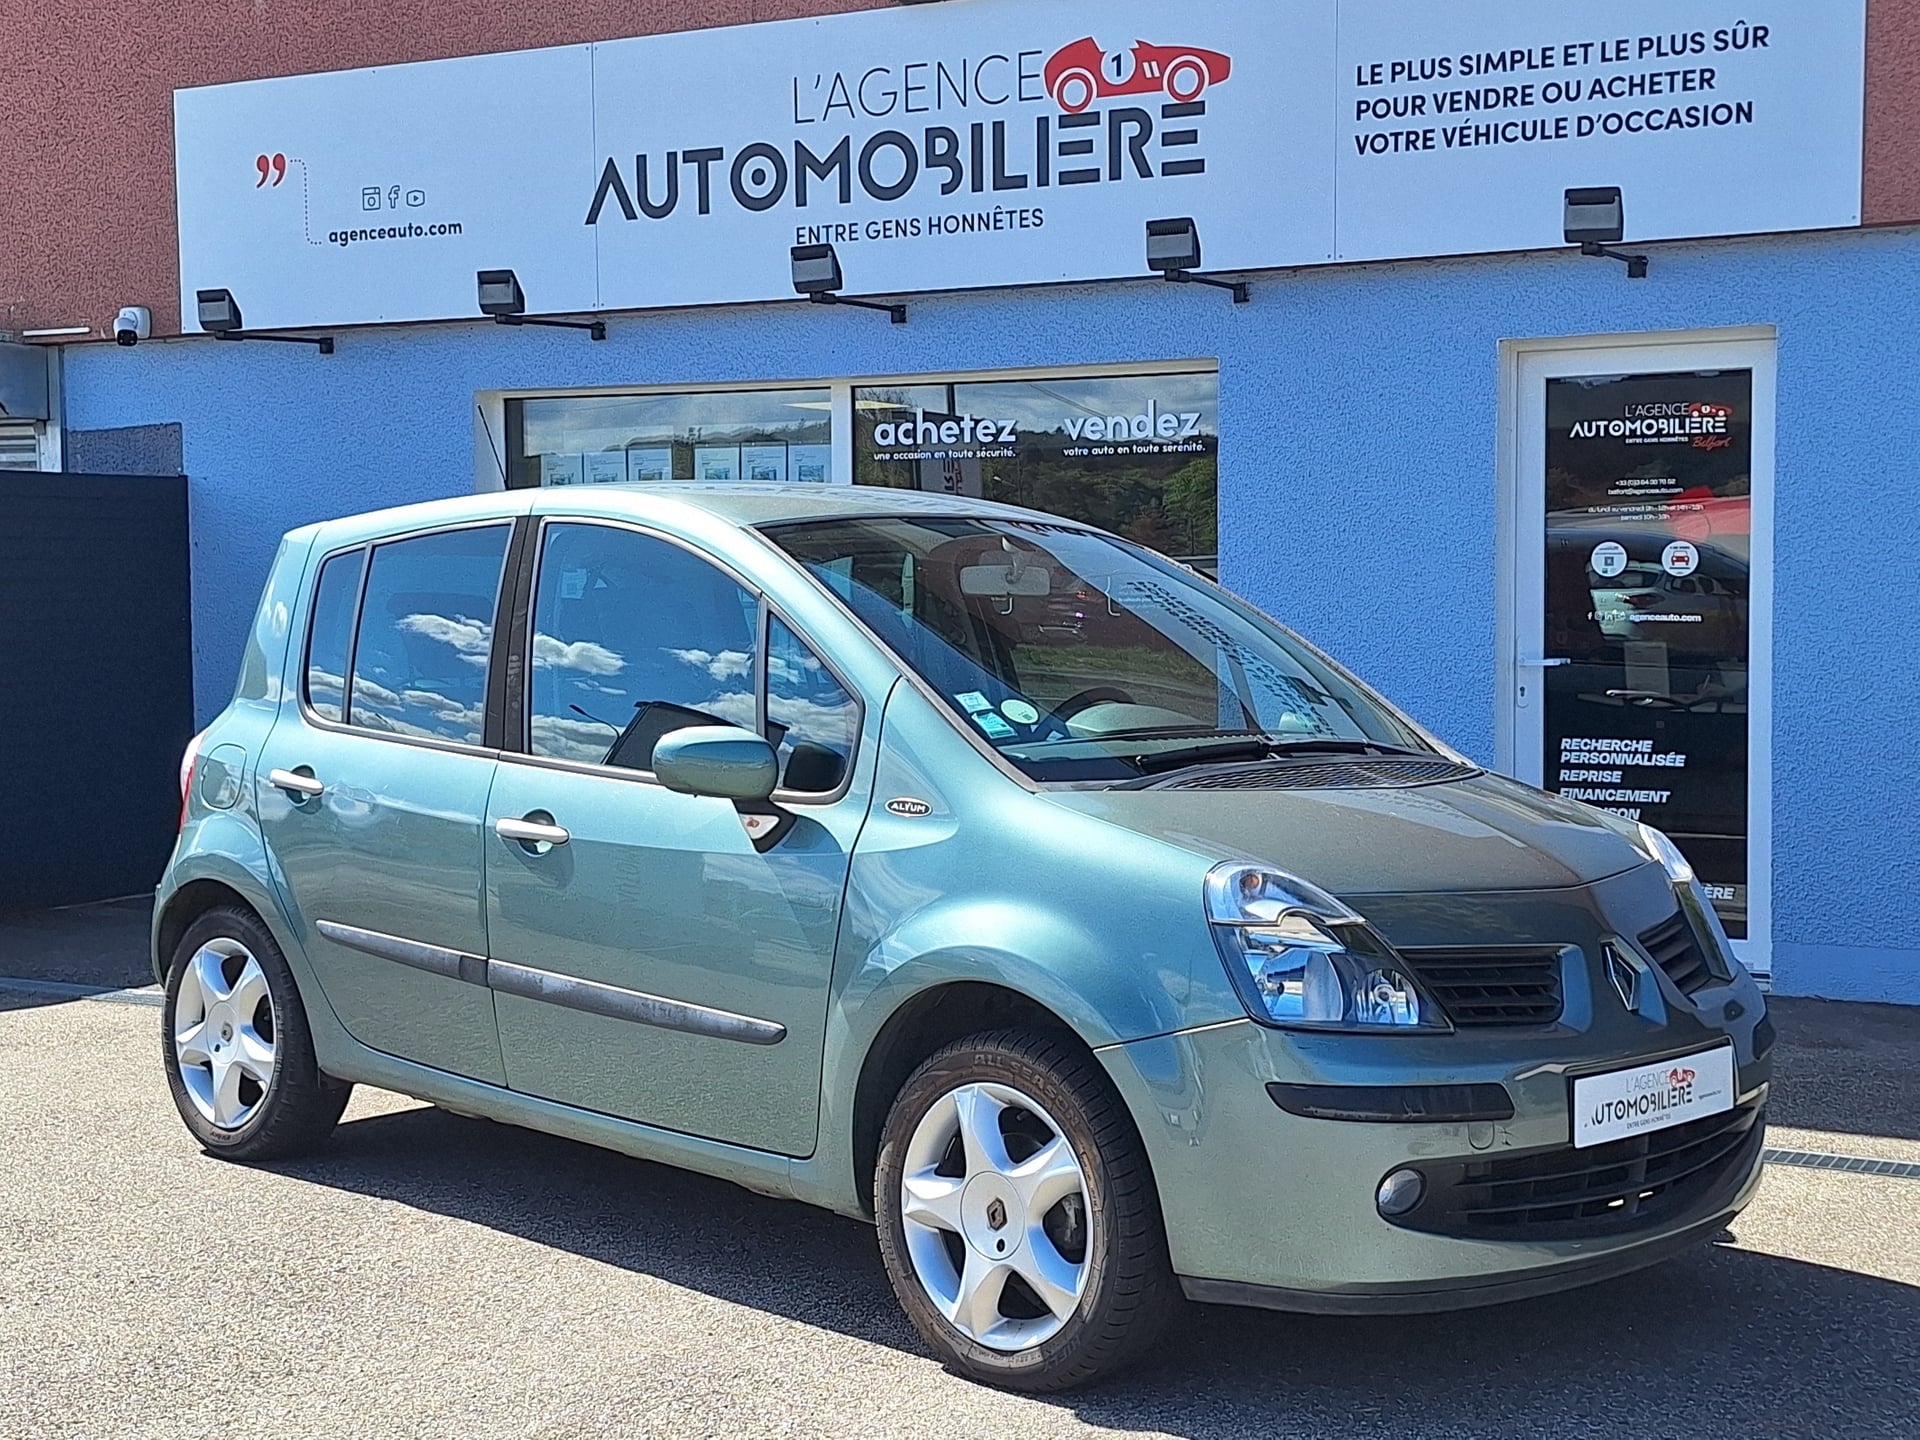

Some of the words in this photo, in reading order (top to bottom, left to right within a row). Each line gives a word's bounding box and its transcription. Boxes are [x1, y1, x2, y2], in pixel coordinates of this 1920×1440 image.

[1111, 53, 1121, 77] 1
[1356, 63, 1384, 87] LE
[1390, 56, 1452, 83] PLUS
[1459, 44, 1555, 77] SIMPLE
[1562, 42, 1595, 66] ET
[1599, 38, 1630, 63] LE
[1637, 31, 1706, 60] PLUS
[1713, 20, 1770, 52] SÛR
[793, 50, 1043, 124] L'AGENCE
[1355, 95, 1426, 121] POUR
[1432, 83, 1535, 115] VENDRE
[1541, 79, 1582, 105] OU
[1587, 67, 1716, 101] ACHETER
[1354, 127, 1436, 155] VOTRE
[1442, 116, 1569, 149] VÉHICULE
[1576, 101, 1754, 138] D'OCCASION
[328, 221, 463, 247] agenceauto.com
[796, 223, 859, 245] ENTRE
[865, 218, 922, 240] GENS
[928, 205, 1044, 235] HONNÊTES
[1064, 399, 1202, 440] vendez
[1624, 402, 1690, 418] L'AGENCE
[874, 408, 1018, 447] achetez
[873, 452, 891, 460] une
[893, 450, 932, 460] occasion
[934, 451, 946, 459] en
[948, 449, 974, 459] toute
[976, 446, 1016, 458] sécurité.
[1063, 447, 1089, 456] votre
[1091, 446, 1115, 455] auto
[1117, 446, 1130, 454] en
[1132, 444, 1159, 454] toute
[1162, 440, 1206, 453] sérénité.
[1560, 738, 1653, 752] RECHERCHE
[1560, 751, 1686, 767] PERSONNALISÉE
[1559, 770, 1622, 783] REPRISE
[1559, 787, 1671, 803] FINANCEMENT
[891, 802, 926, 813] ALYUM
[1625, 1069, 1671, 1093] L'AGENCE
